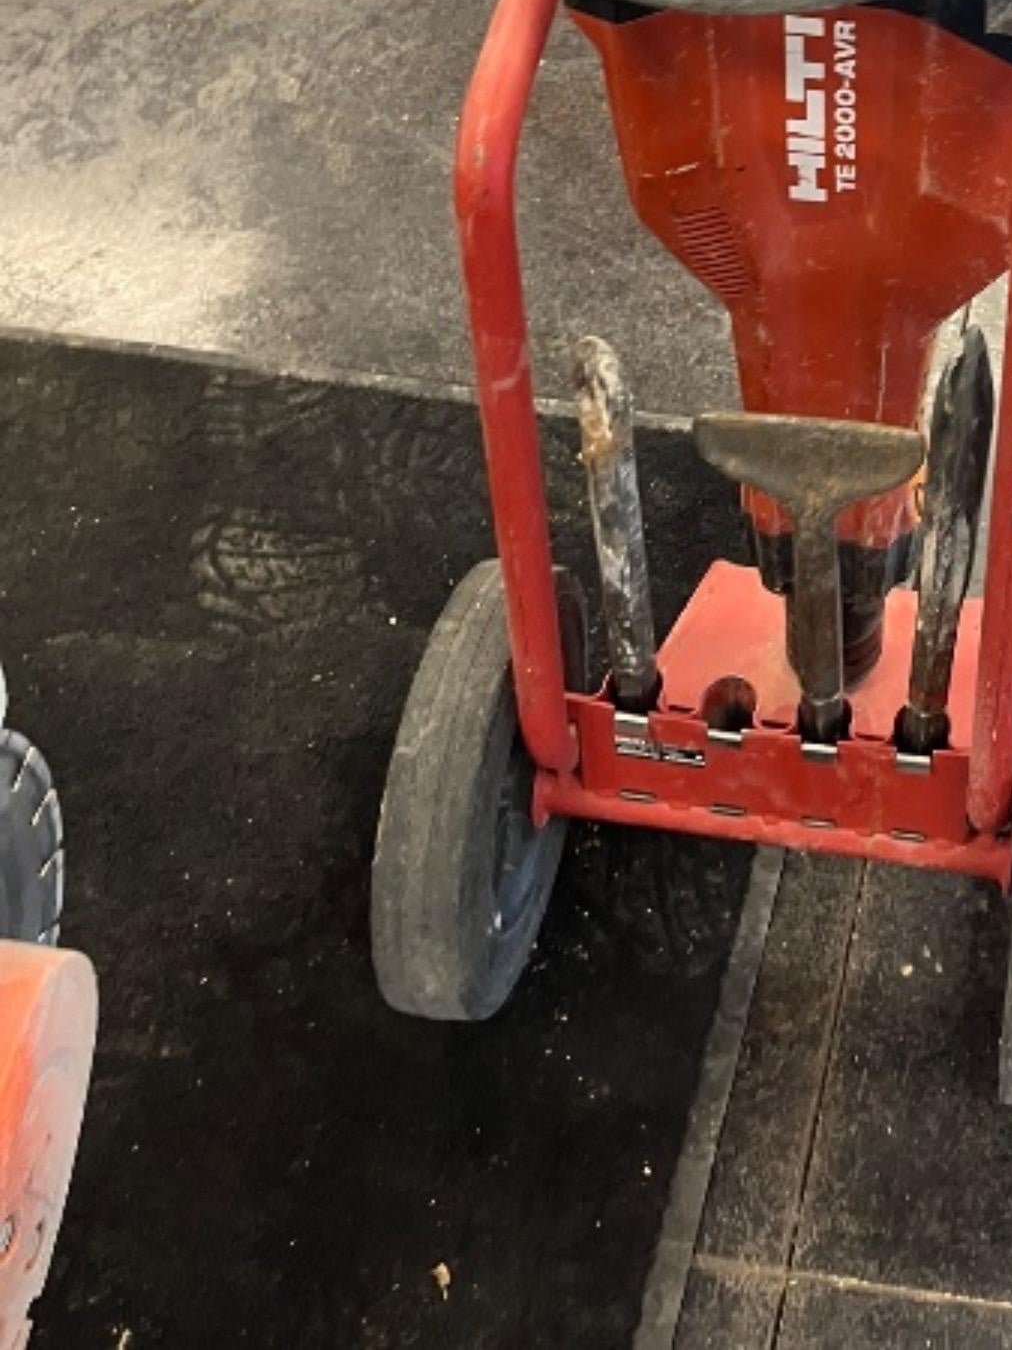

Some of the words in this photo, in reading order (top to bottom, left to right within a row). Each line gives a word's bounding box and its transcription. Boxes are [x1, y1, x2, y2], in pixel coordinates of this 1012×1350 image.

[785, 15, 828, 202] HILTI
[833, 20, 857, 160] 2000-AVR
[833, 164, 857, 193] TE
